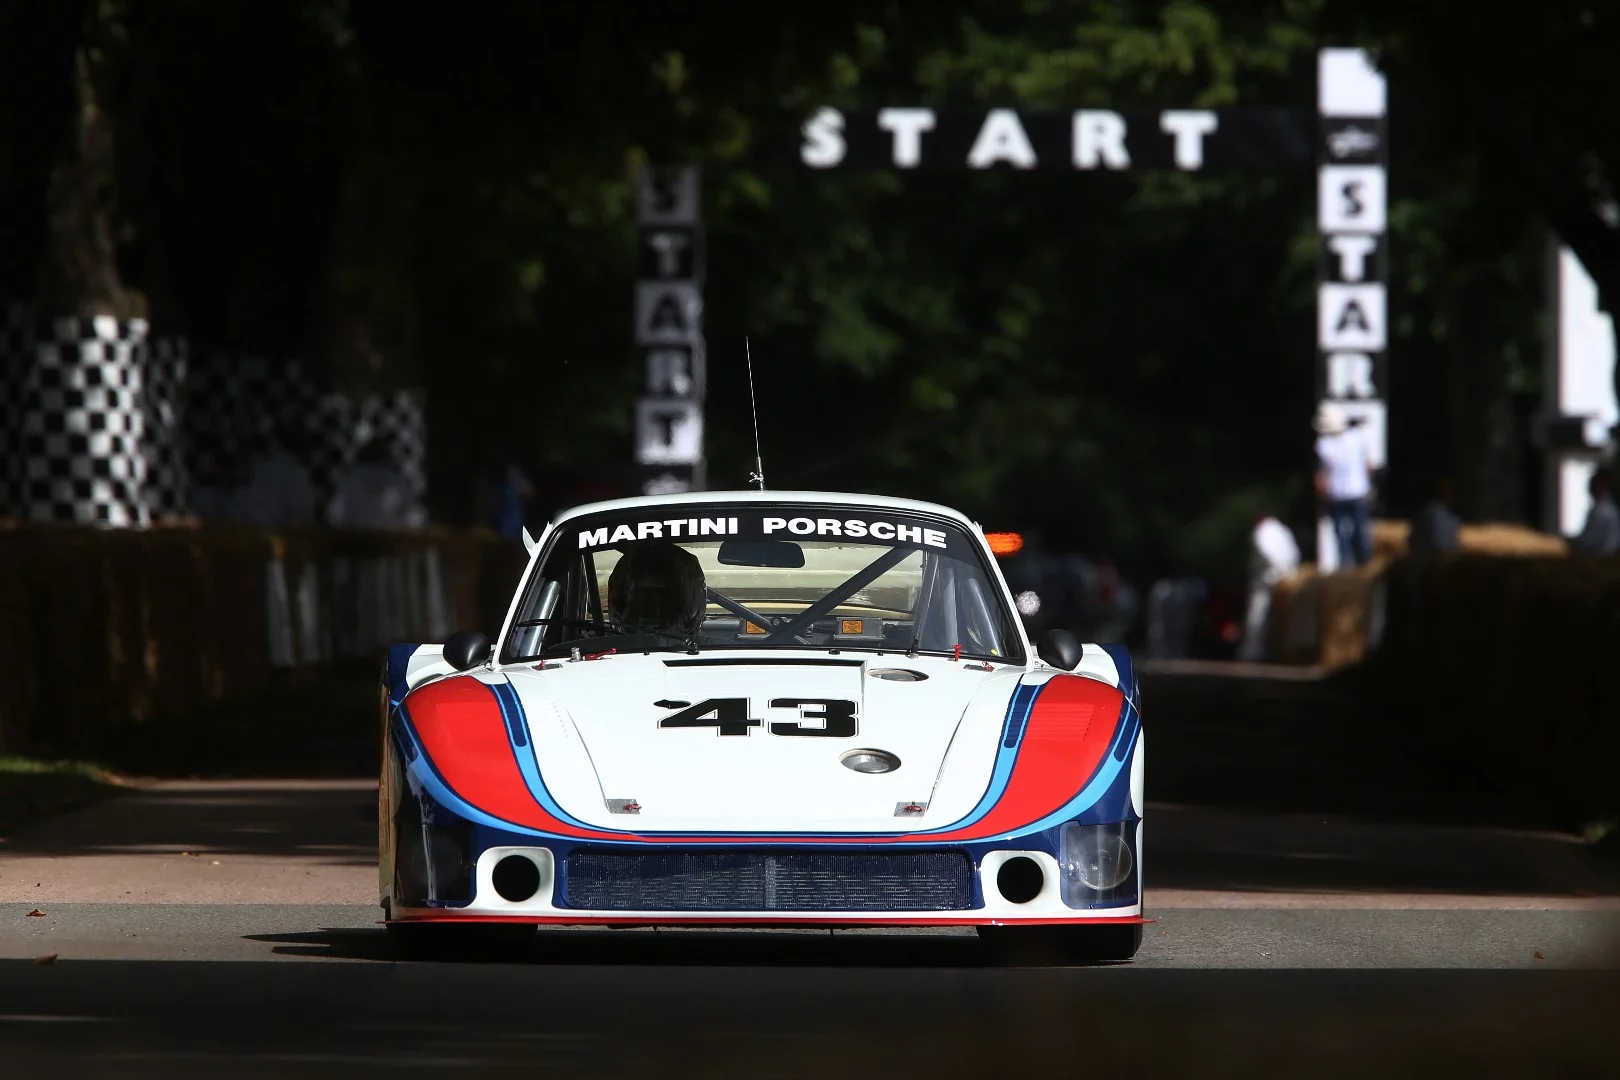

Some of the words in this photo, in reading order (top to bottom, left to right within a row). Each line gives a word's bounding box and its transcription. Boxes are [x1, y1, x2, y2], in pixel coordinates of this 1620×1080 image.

[801, 106, 1219, 169] START
[578, 517, 738, 549] MARTINI
[763, 517, 947, 549] PORSCHE
[656, 697, 860, 737] 43
